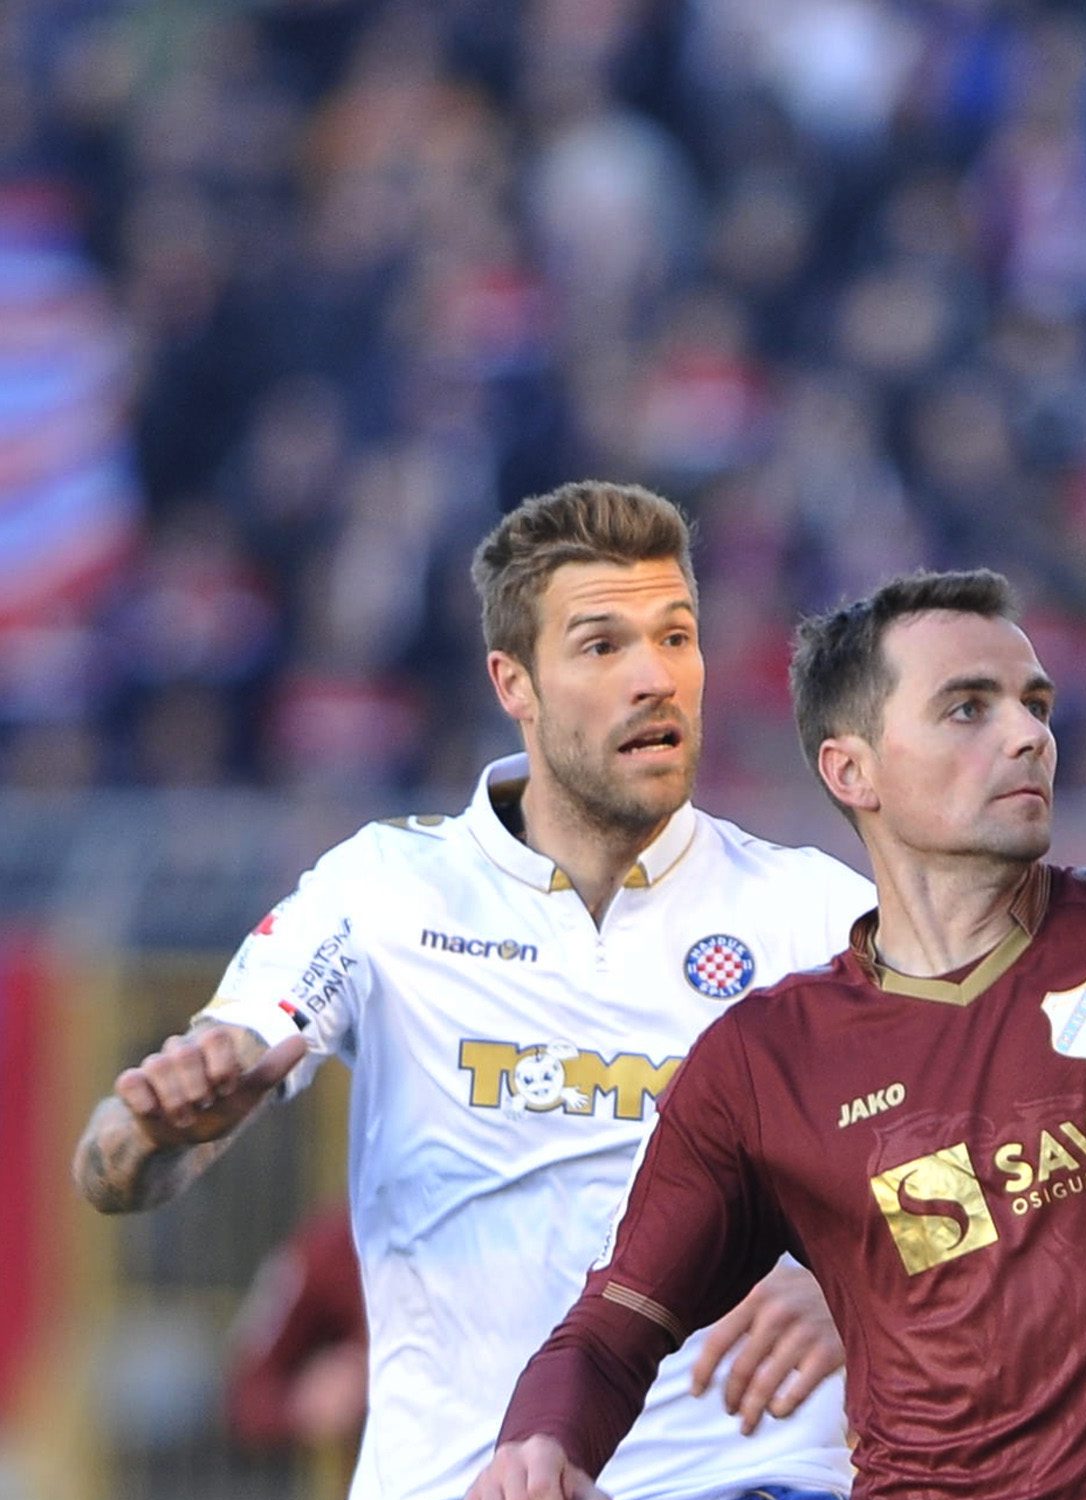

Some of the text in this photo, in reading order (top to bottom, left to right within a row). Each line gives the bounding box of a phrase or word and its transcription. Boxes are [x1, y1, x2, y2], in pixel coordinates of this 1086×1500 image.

[421, 929, 538, 963] macron
[306, 954, 359, 1014] BANA
[837, 1082, 906, 1129] JAKO
